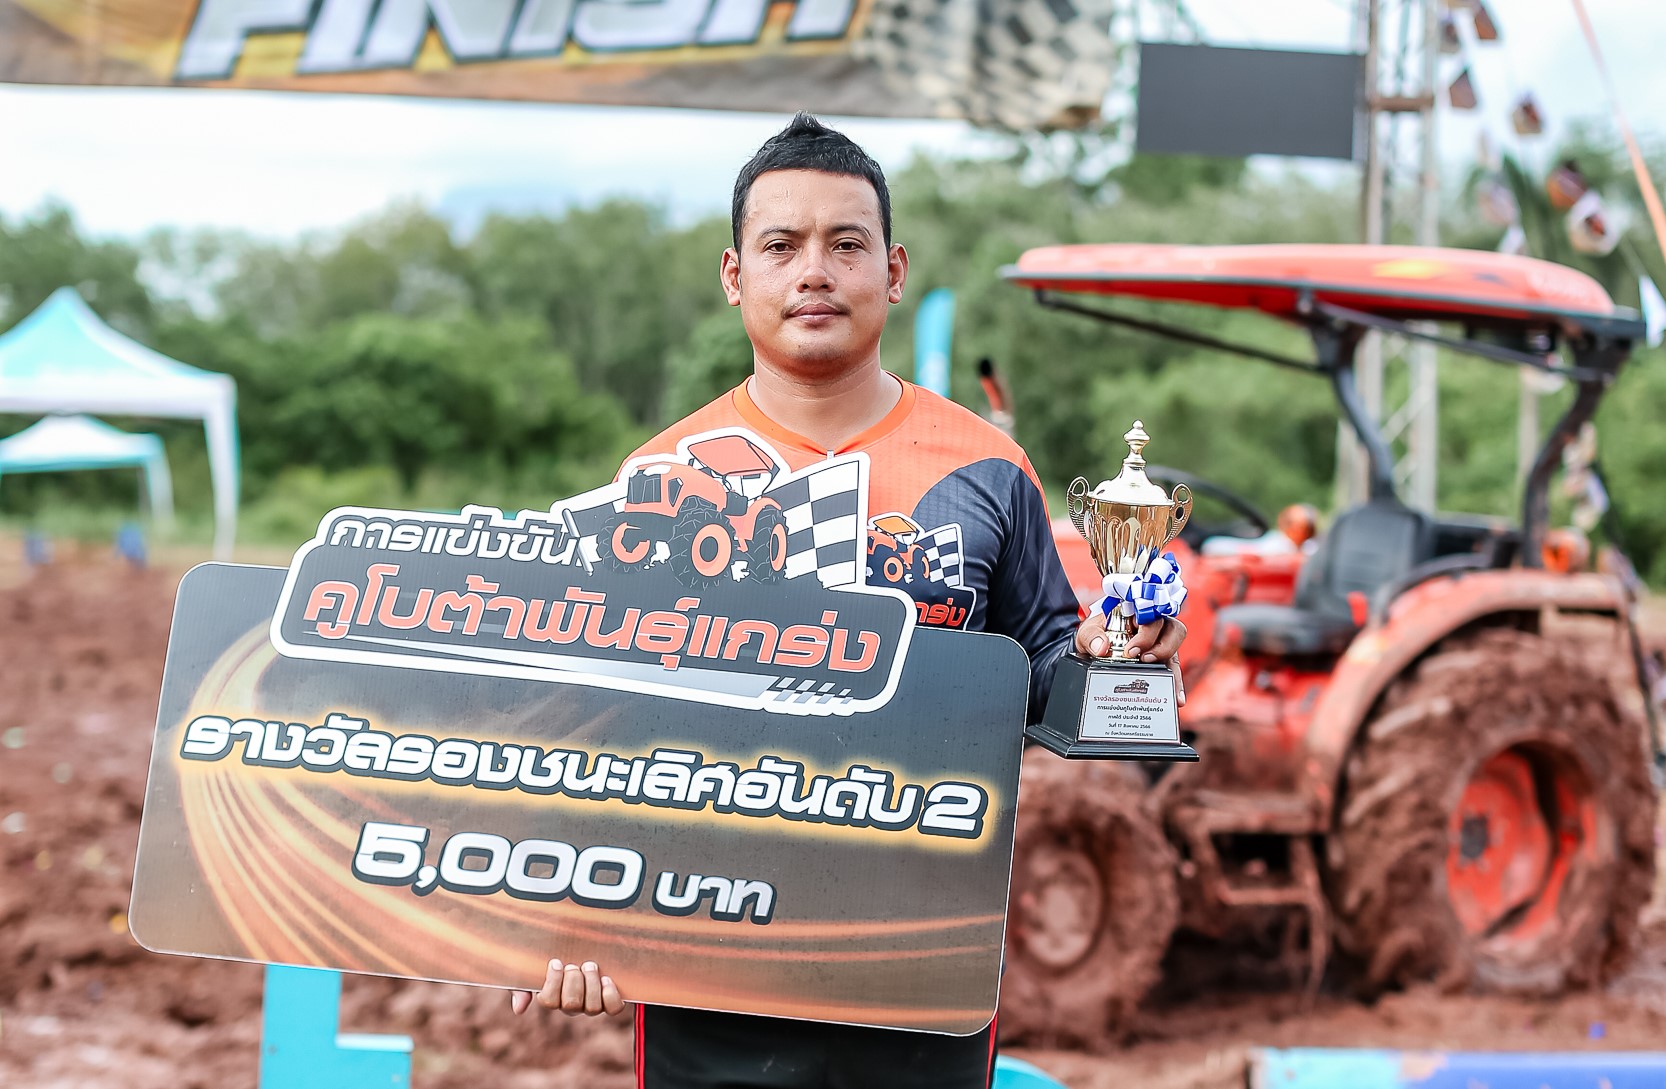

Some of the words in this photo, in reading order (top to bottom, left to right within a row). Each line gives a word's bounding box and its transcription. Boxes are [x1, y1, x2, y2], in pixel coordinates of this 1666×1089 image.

[329, 518, 578, 567] การแข่งขัน
[302, 562, 882, 674] คูโบต้าพันธุ์แกร่ง
[1093, 695, 1162, 704] รางวัลรองชนะเลิศอันดับ
[181, 713, 923, 830] รางวัลรองชนะเลิศอันดับ
[918, 781, 988, 839] 2
[351, 821, 646, 909] 5,000
[653, 870, 777, 925] บาท
